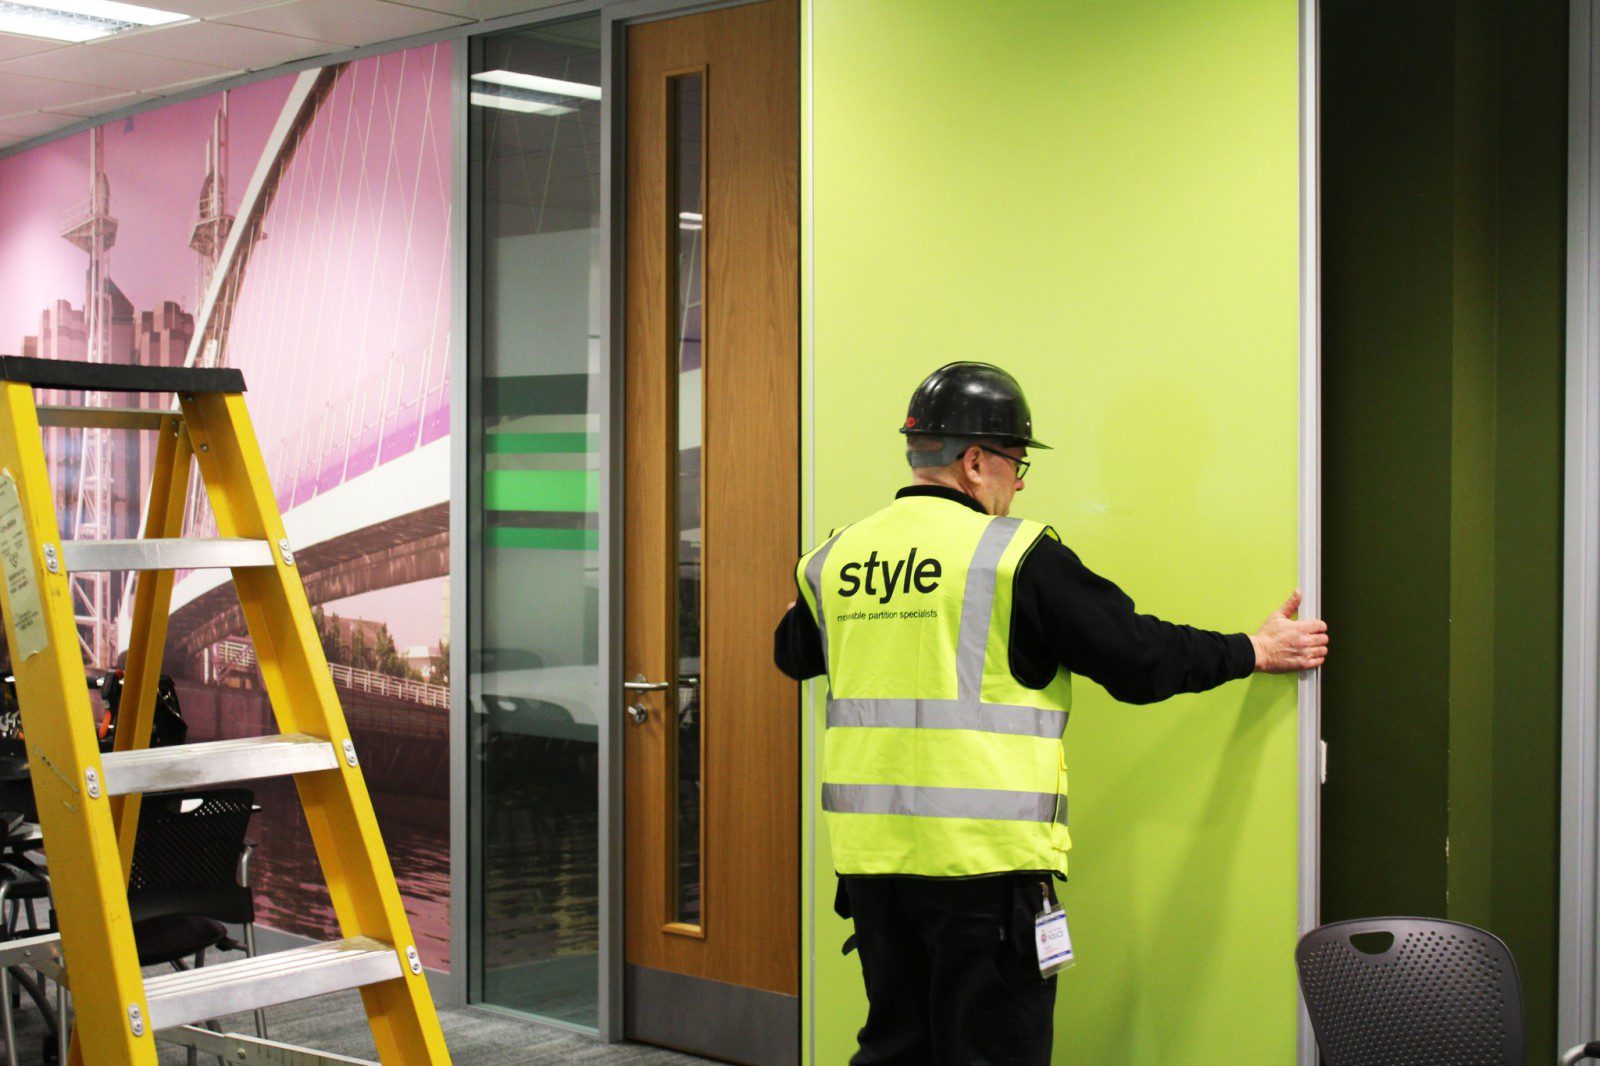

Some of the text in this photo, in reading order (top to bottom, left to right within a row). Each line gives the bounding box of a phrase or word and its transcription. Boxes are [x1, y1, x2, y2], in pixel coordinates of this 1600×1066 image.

[837, 547, 942, 604] style
[868, 609, 897, 620] partition
[899, 609, 938, 619] specialists
